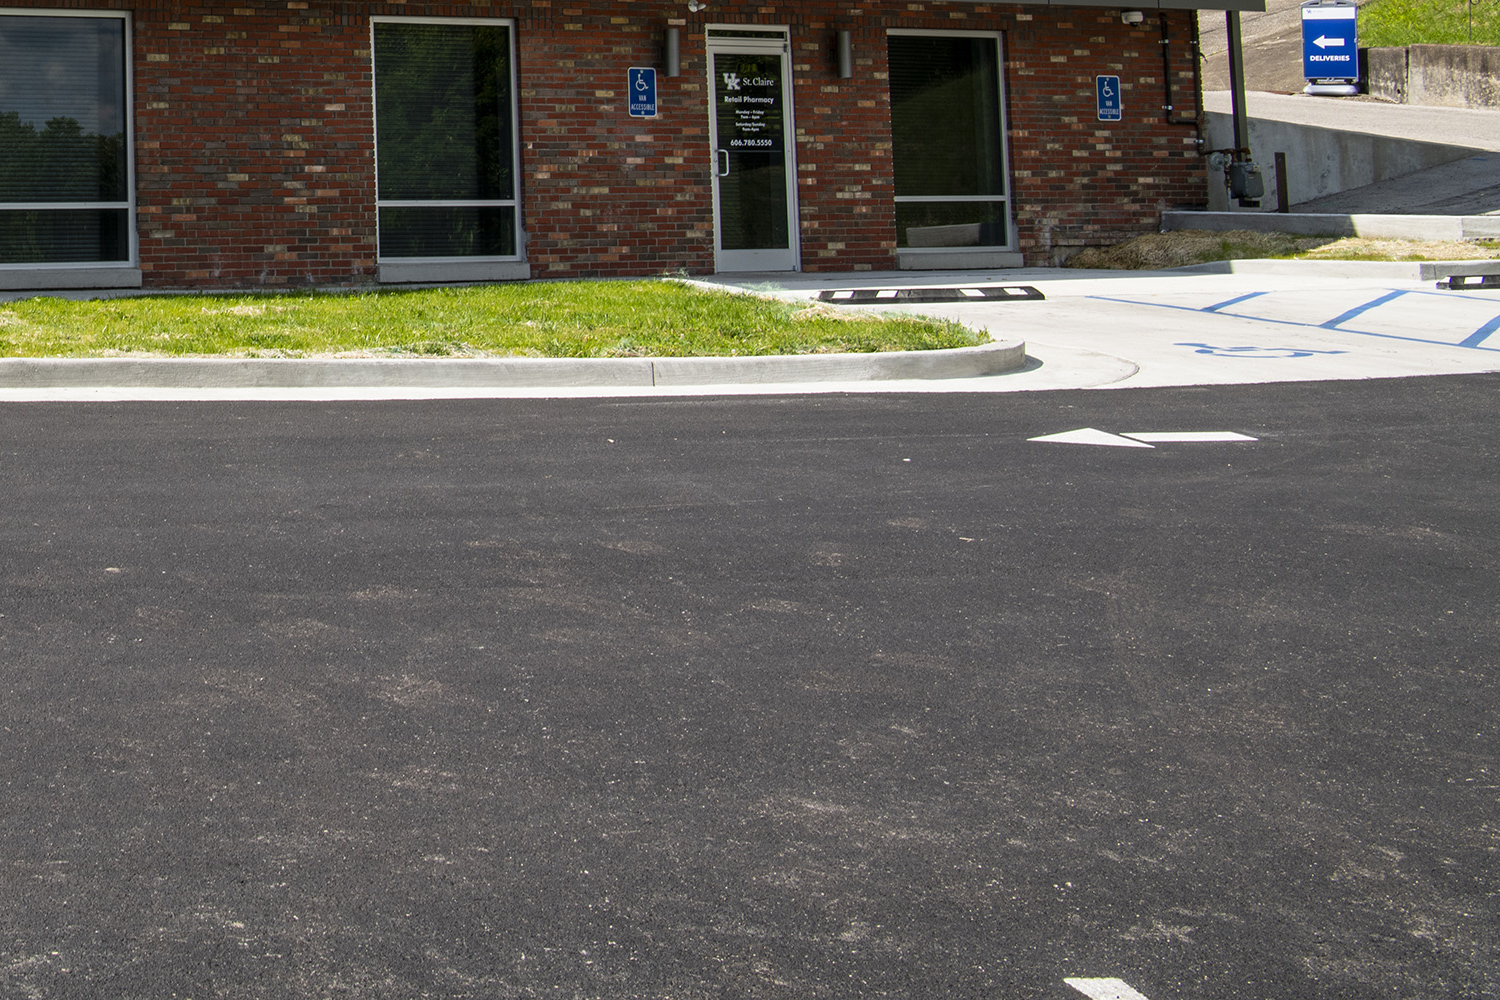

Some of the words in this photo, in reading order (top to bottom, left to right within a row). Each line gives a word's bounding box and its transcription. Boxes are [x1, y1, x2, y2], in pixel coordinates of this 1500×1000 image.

[722, 72, 741, 90] UK
[742, 77, 752, 86] St.
[752, 77, 774, 86] Claire
[743, 96, 774, 104] Pharmacy
